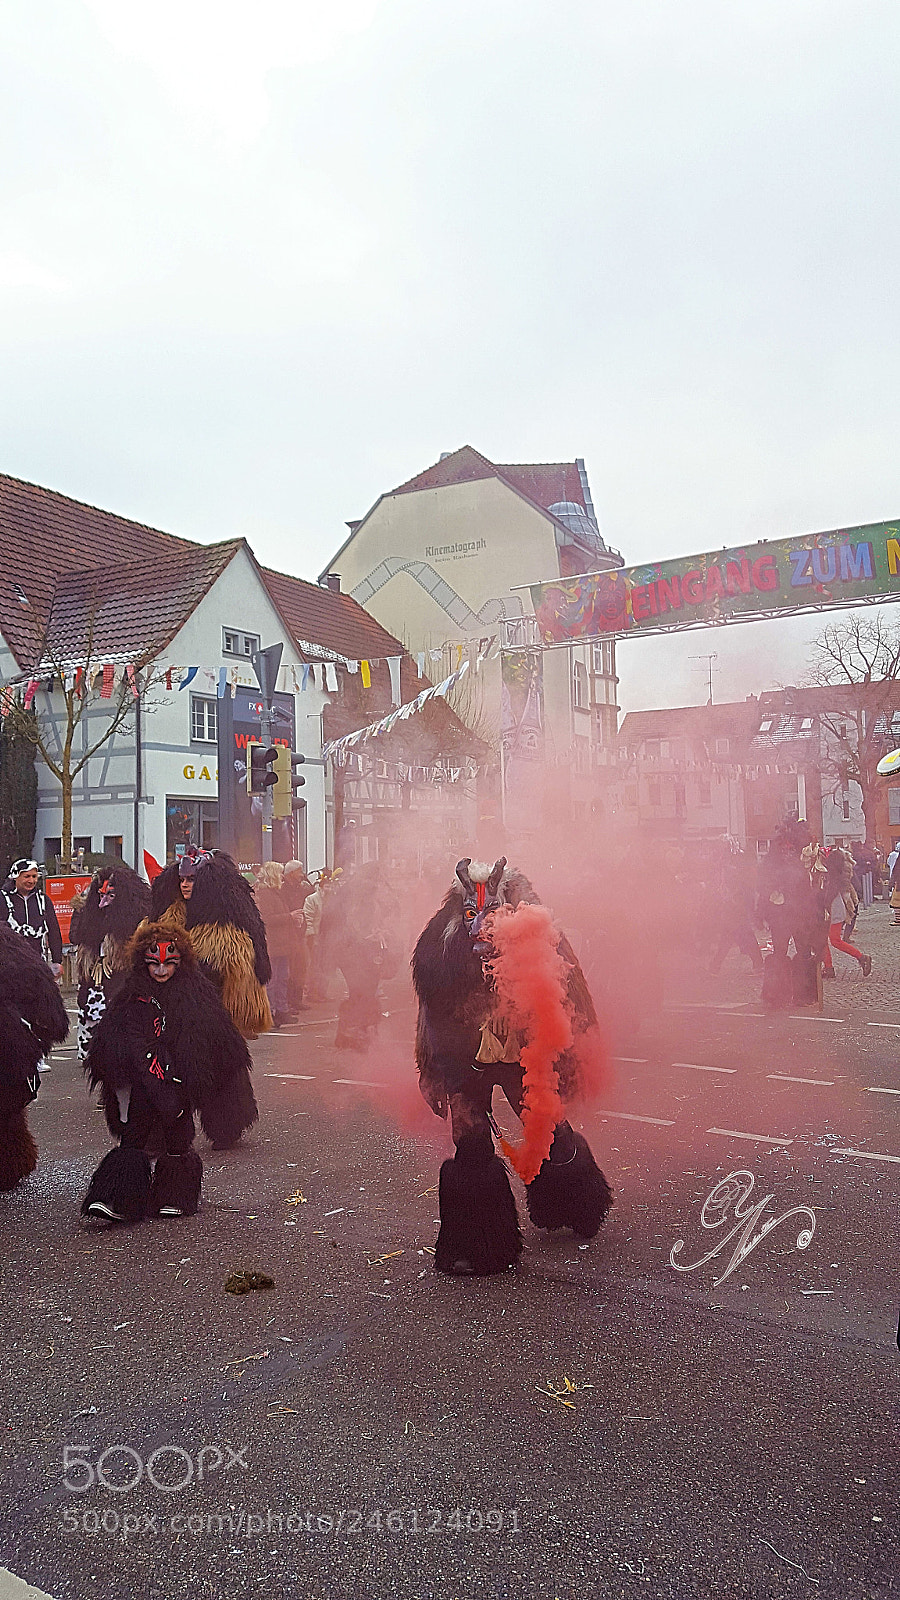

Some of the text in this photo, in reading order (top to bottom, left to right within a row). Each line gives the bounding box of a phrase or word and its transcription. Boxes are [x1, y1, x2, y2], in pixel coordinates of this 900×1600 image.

[425, 538, 487, 557] Kinematograph
[631, 555, 778, 621] EINGANG
[789, 542, 873, 586] ZUM
